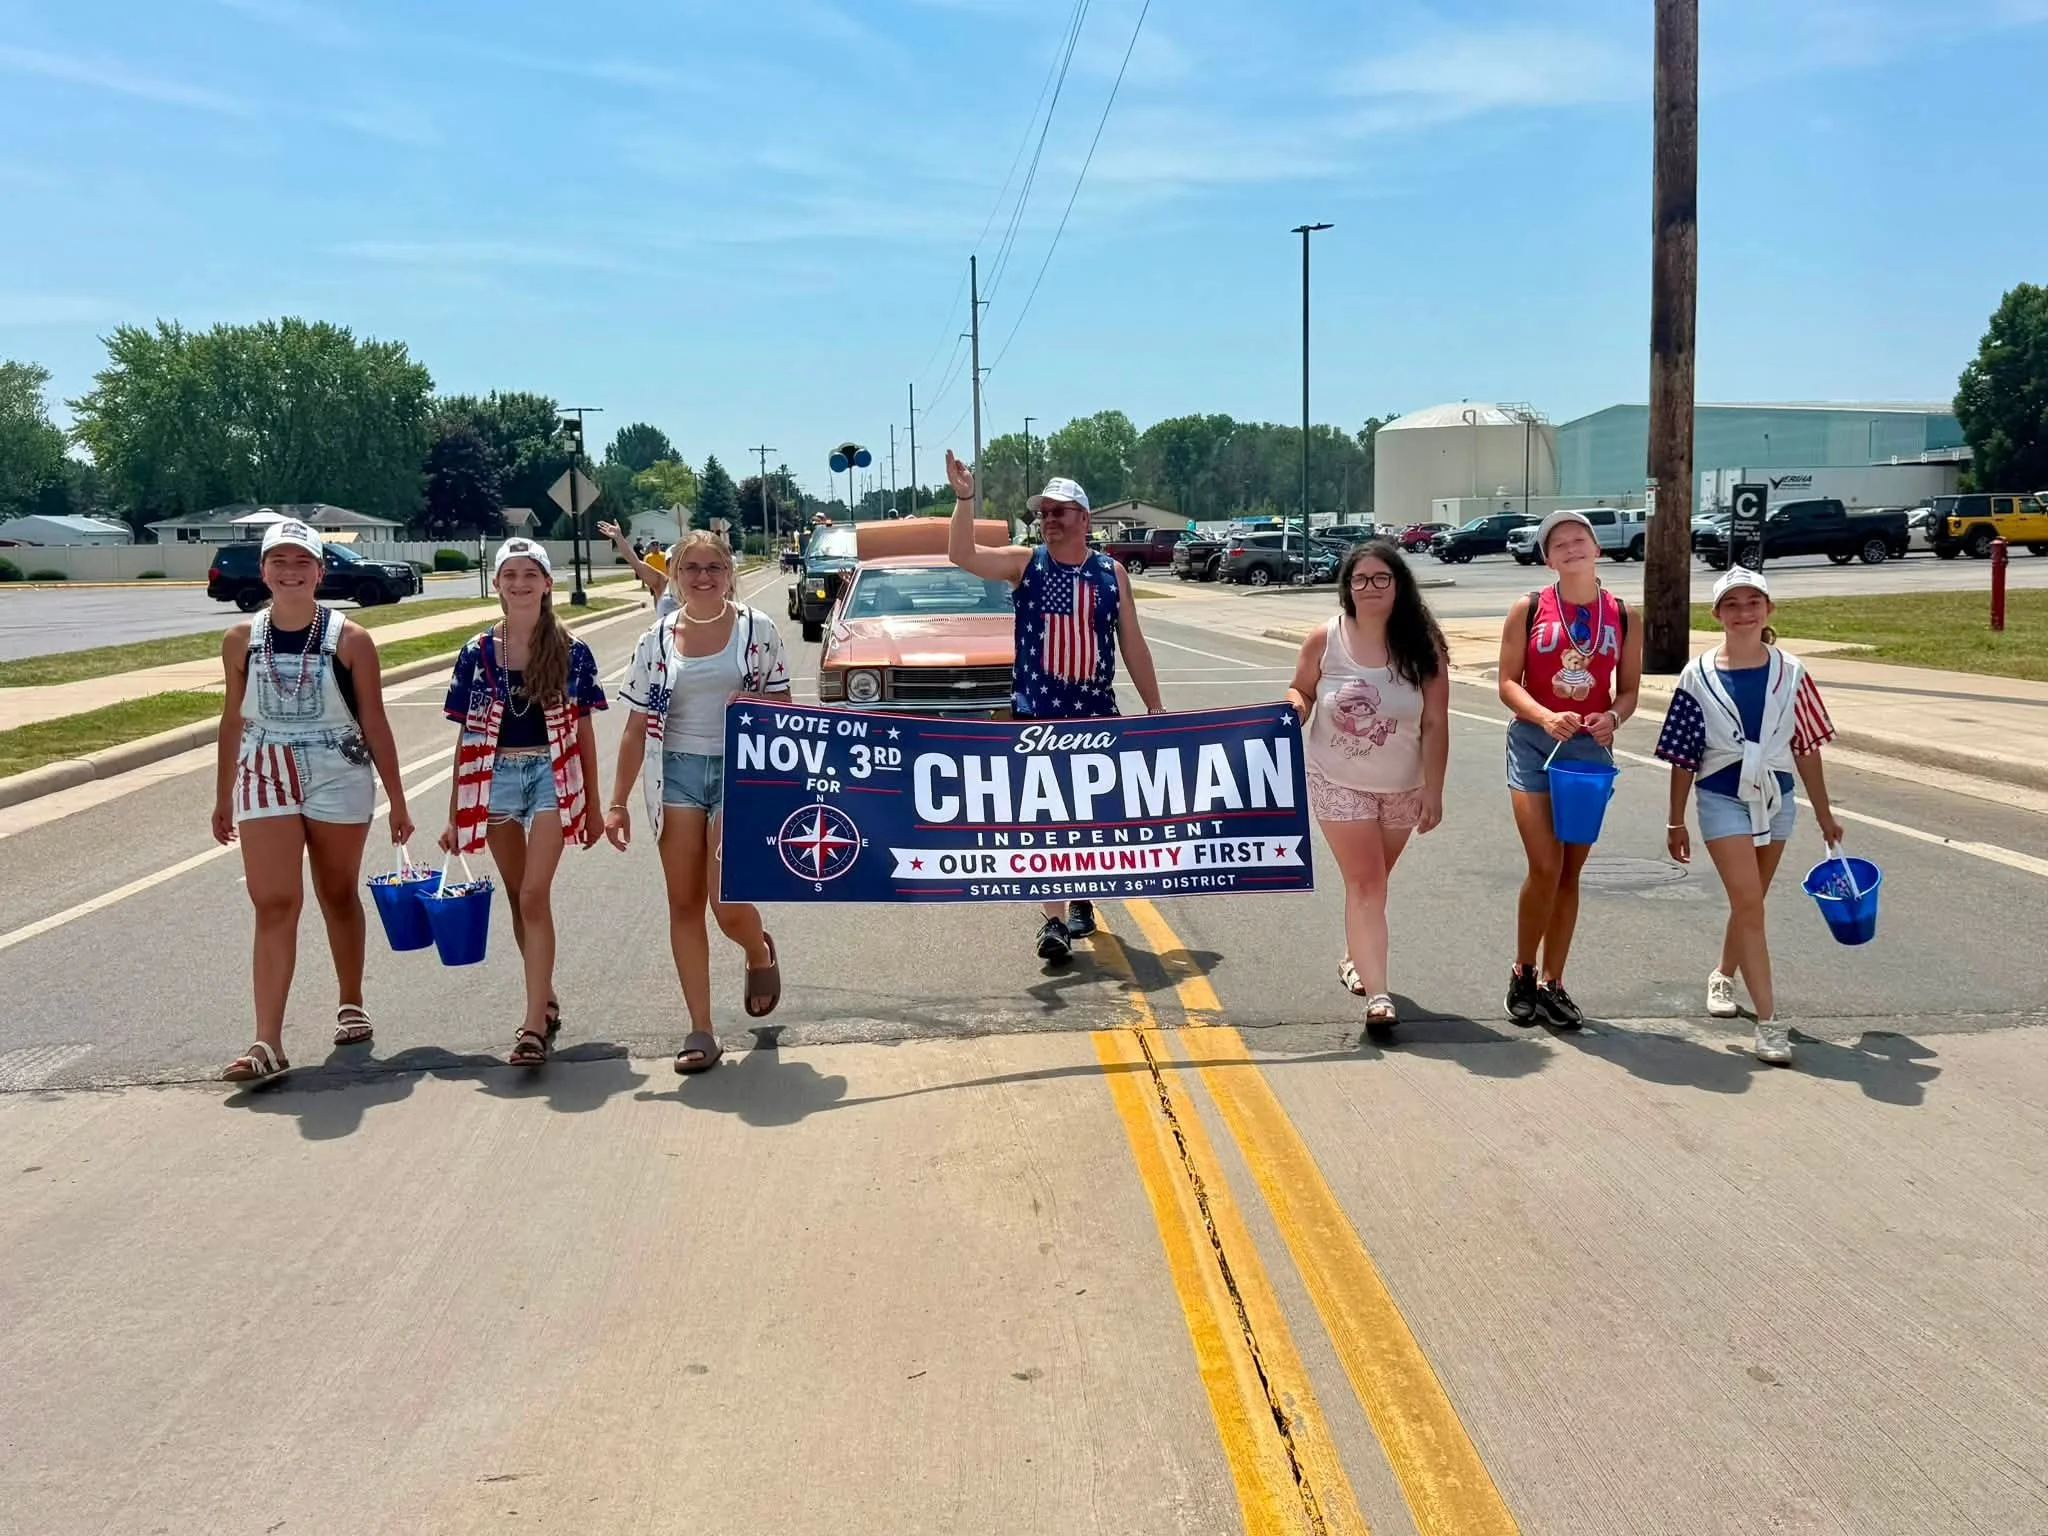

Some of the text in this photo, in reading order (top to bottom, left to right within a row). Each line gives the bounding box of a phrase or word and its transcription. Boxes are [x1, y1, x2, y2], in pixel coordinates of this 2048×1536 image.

[1736, 492, 1758, 518] C
[1534, 621, 1619, 660] UA
[774, 713, 868, 738] VOTE ON
[1014, 725, 1117, 754] Shena
[737, 733, 902, 779] NOV. 3RD
[806, 778, 841, 793] FOR
[913, 737, 1295, 823] CHAPMAN
[816, 794, 824, 802] N
[766, 836, 777, 846] W
[862, 838, 869, 847] E
[977, 820, 1224, 847] INDEPENDENT
[939, 841, 1265, 874] OUR COMMUNITY FIRST
[814, 882, 823, 892] S
[970, 874, 1236, 896] STATE ASSEMBLY 36TH DISTRICT
